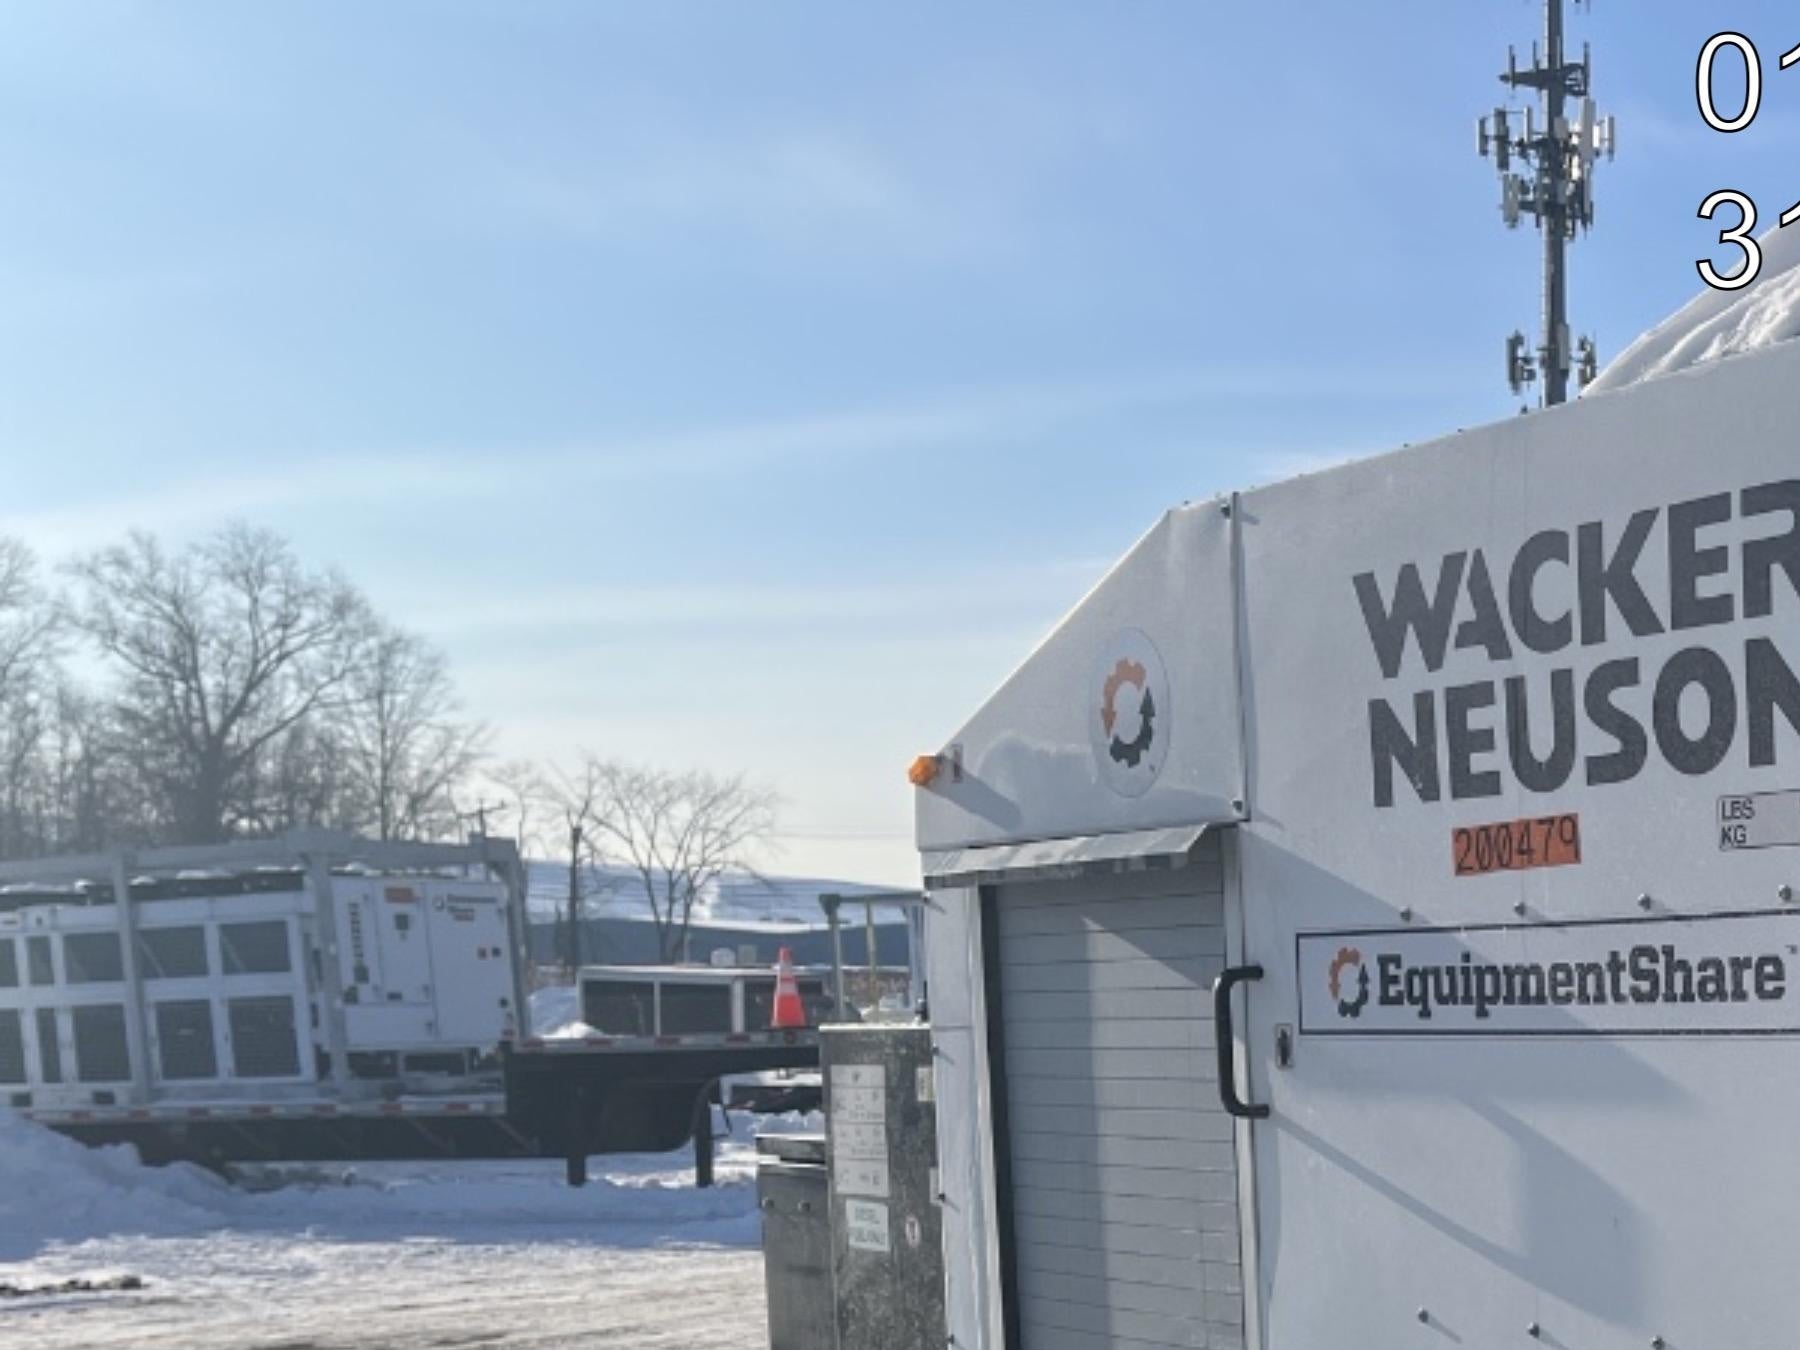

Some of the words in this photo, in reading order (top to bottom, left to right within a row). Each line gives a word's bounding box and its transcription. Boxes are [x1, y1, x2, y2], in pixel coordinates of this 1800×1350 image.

[1721, 800, 1756, 822] LBS
[1454, 814, 1580, 873] 200479
[1721, 824, 1747, 846] KG
[1376, 945, 1787, 1018] EquipmentShare
